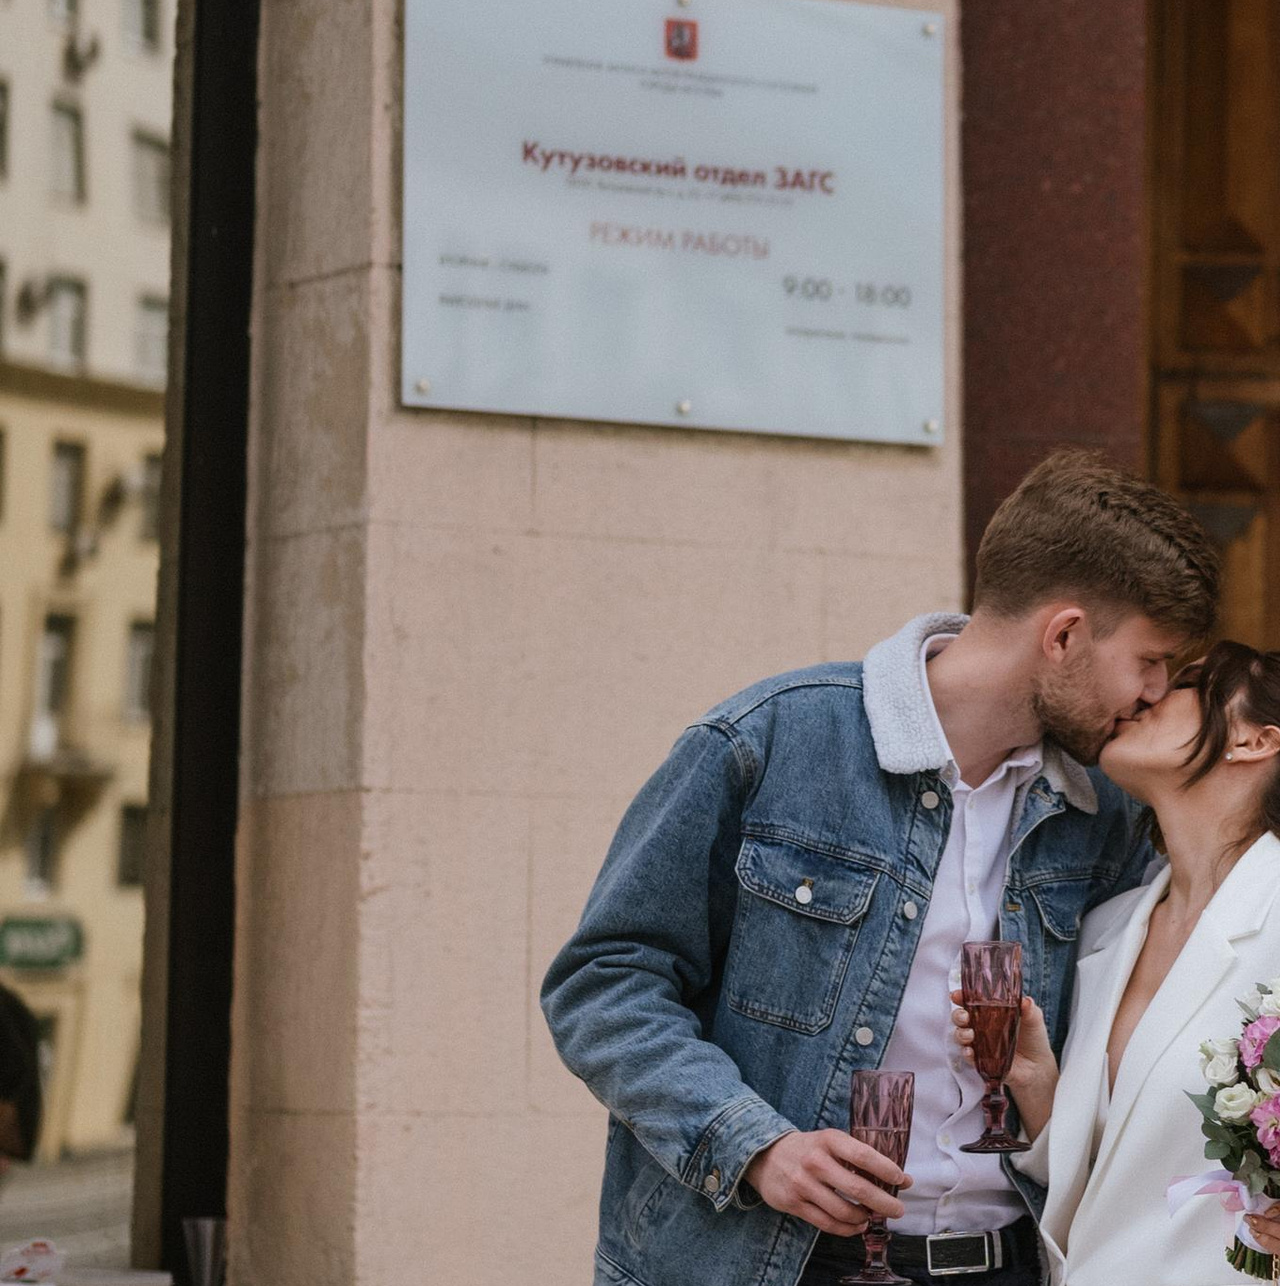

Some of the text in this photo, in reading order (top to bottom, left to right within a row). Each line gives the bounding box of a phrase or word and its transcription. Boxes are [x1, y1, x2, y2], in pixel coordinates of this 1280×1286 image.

[522, 140, 686, 178] Кутузовский
[694, 166, 767, 187] отдел
[774, 165, 835, 195] ЗАГС
[589, 220, 769, 260] РЕЖИМ РАБОТЫ
